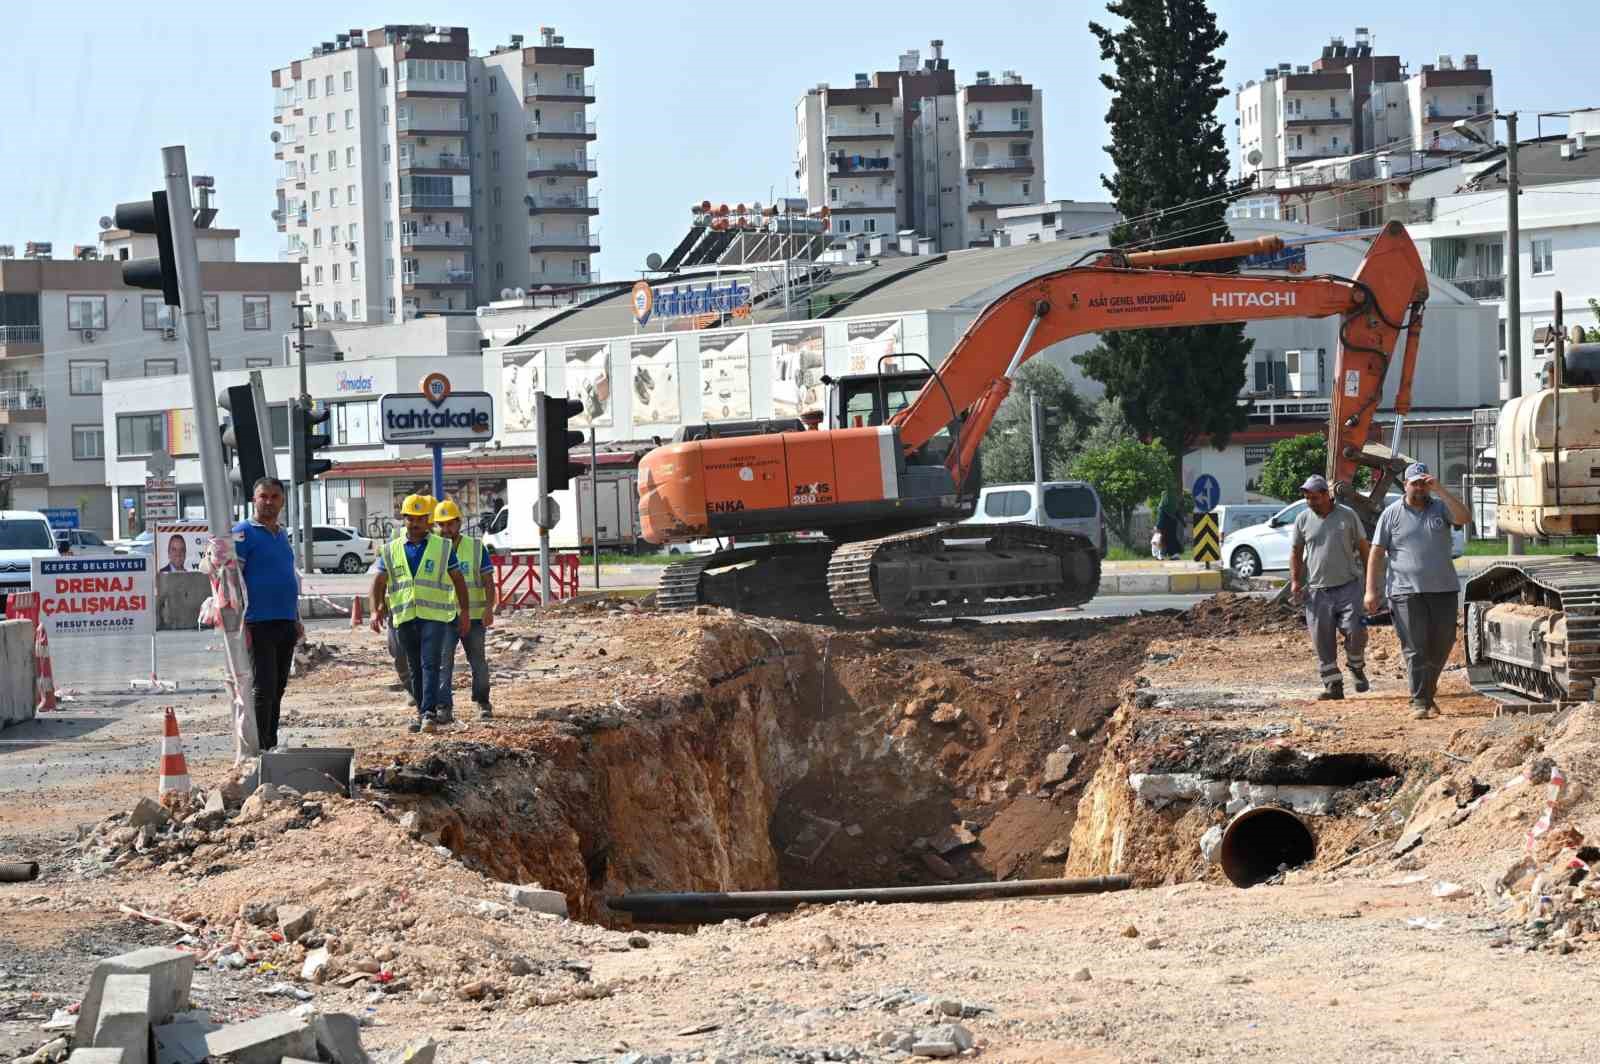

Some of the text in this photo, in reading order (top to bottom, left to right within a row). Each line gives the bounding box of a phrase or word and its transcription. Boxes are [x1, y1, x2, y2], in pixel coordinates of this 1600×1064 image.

[1212, 292, 1296, 306] HITACHI
[387, 408, 489, 430] tahtakale
[795, 482, 830, 495] ZAXIS
[706, 500, 745, 513] ENKA
[44, 560, 144, 571] KEPEZ BELEDİYESİ
[55, 576, 134, 594] DRENAJ
[42, 595, 147, 617] ÇALIŞMASI
[56, 617, 135, 629] MESUT KOCAGÖZ
